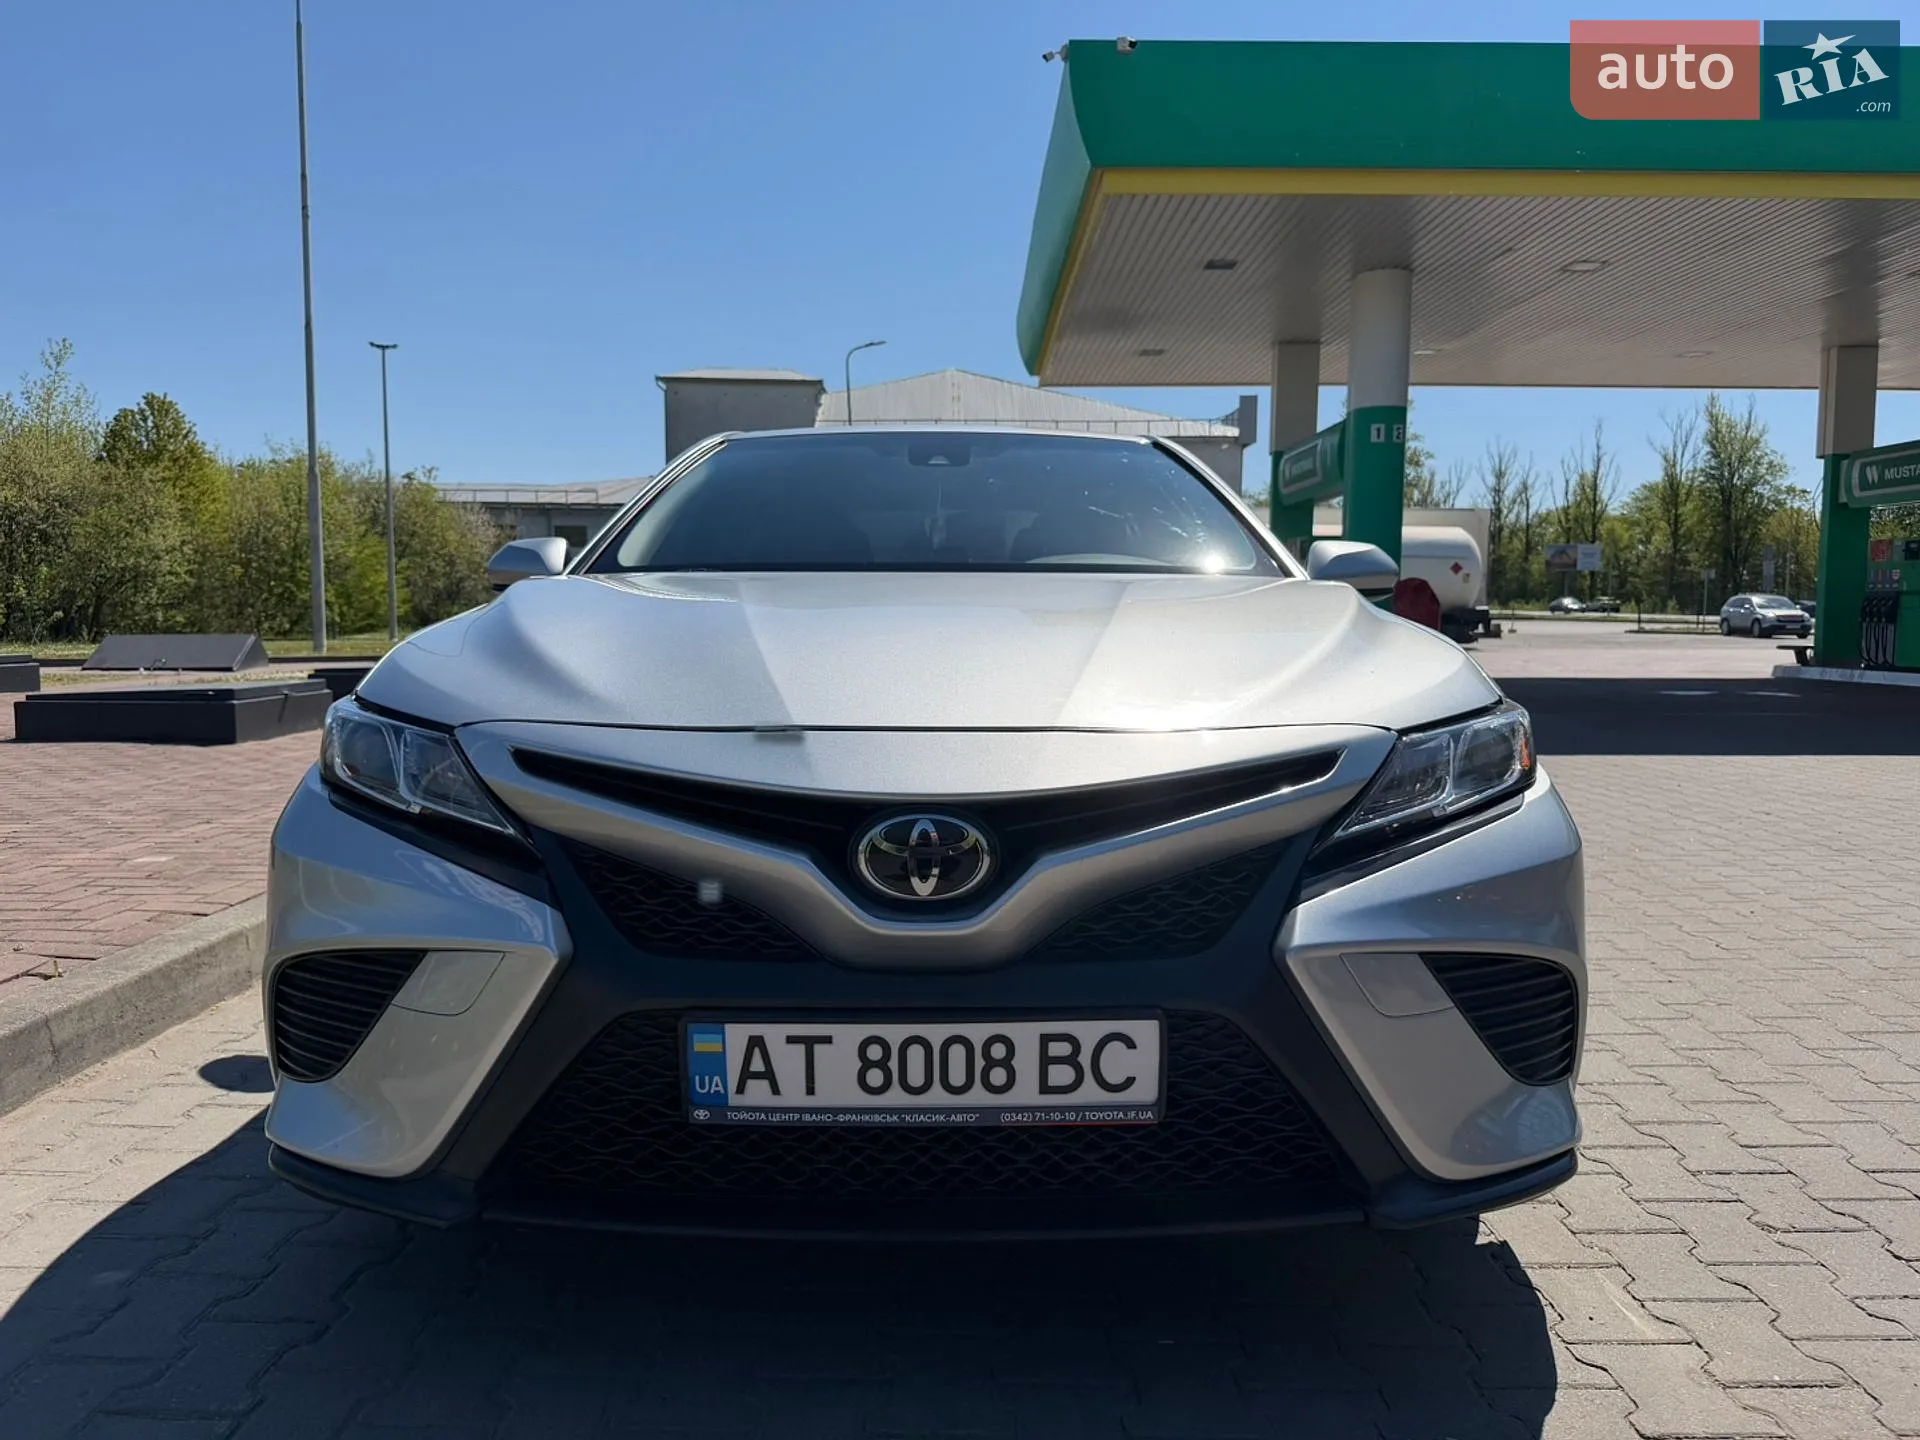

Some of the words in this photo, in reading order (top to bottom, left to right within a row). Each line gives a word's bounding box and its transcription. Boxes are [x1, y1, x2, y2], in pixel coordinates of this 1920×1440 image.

[735, 1034, 833, 1096] AT
[857, 1033, 1016, 1096] 8008
[1038, 1031, 1138, 1095] BC
[695, 1076, 725, 1094] UA
[727, 1110, 768, 1121] ТОЙОТА
[768, 1112, 800, 1122] ЦЕНТР
[801, 1112, 899, 1123] ІВАНО-ФРАНКІВСЬК
[1001, 1111, 1032, 1122] (0342)
[1035, 1111, 1076, 1121] 71-10-10
[1085, 1110, 1154, 1120] TOYOTA.IF.UA
